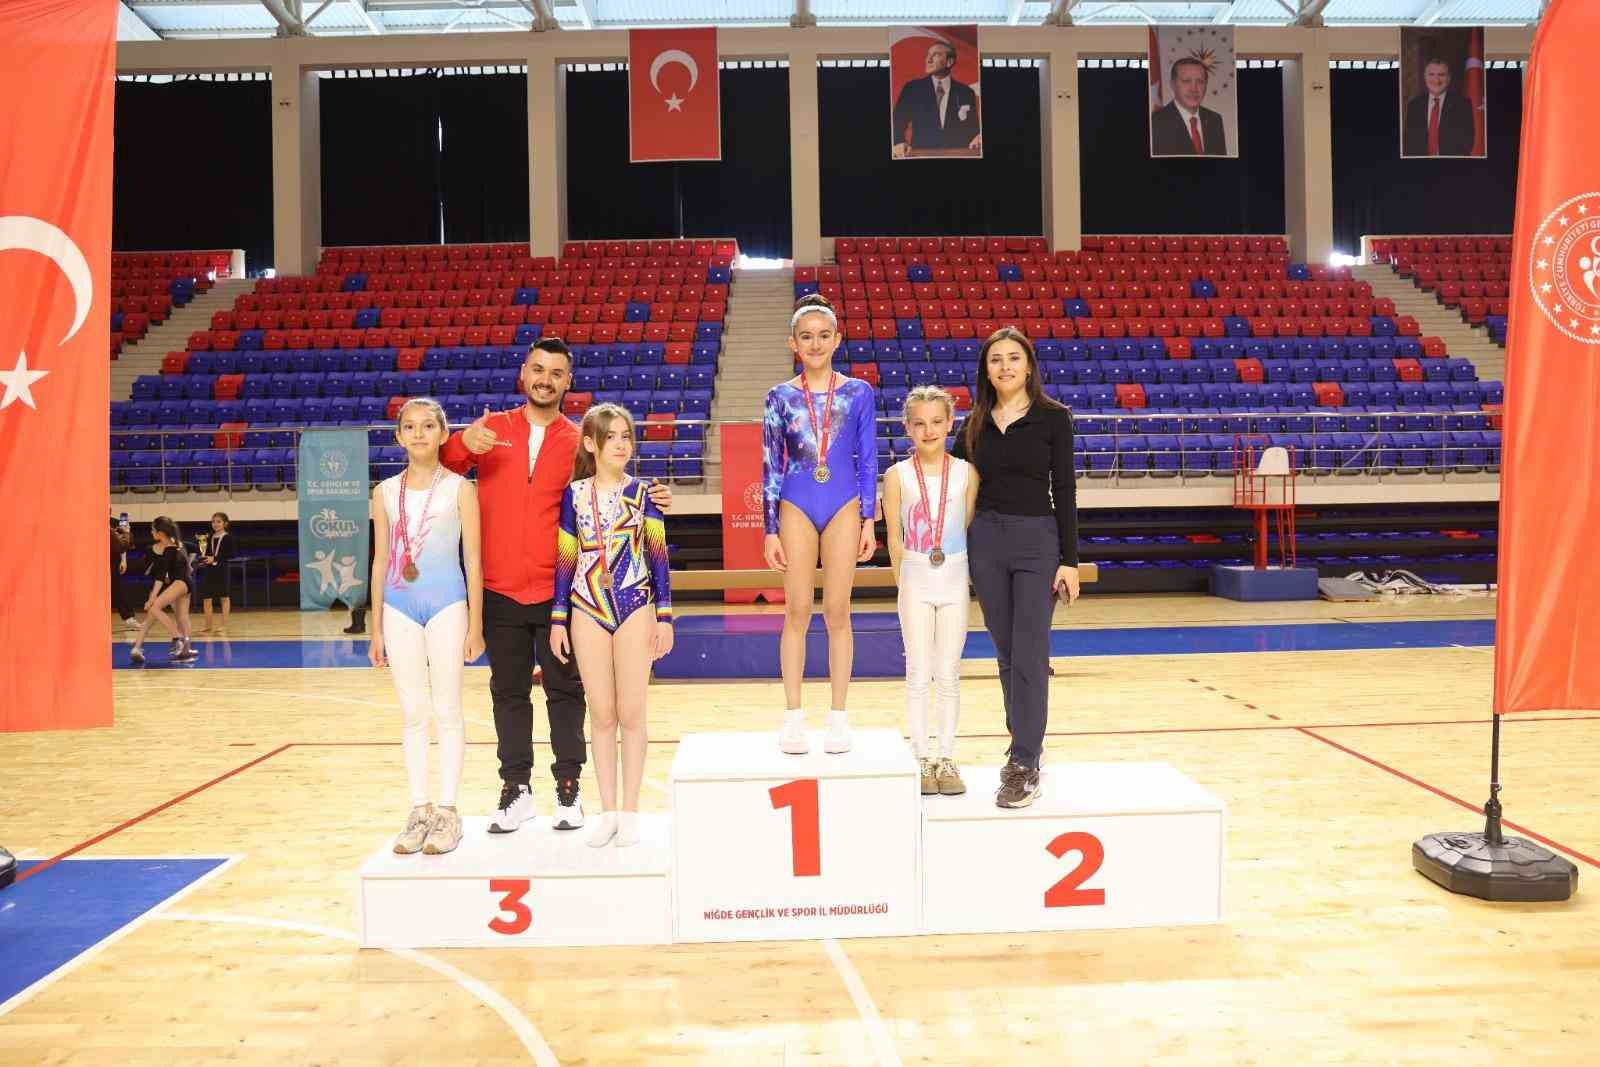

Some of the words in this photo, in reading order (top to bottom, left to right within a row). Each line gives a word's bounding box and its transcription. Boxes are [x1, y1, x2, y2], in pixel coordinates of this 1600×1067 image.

[768, 778, 821, 877] 1
[1044, 832, 1104, 908] 2
[489, 879, 532, 935] 3
[704, 908, 733, 920] NİĞDE
[735, 907, 776, 920] GENÇLİK
[778, 908, 789, 918] VE
[792, 907, 817, 918] SPOR
[819, 905, 828, 916] İL
[829, 903, 889, 916] MÜDÜRLÜĞÜ
